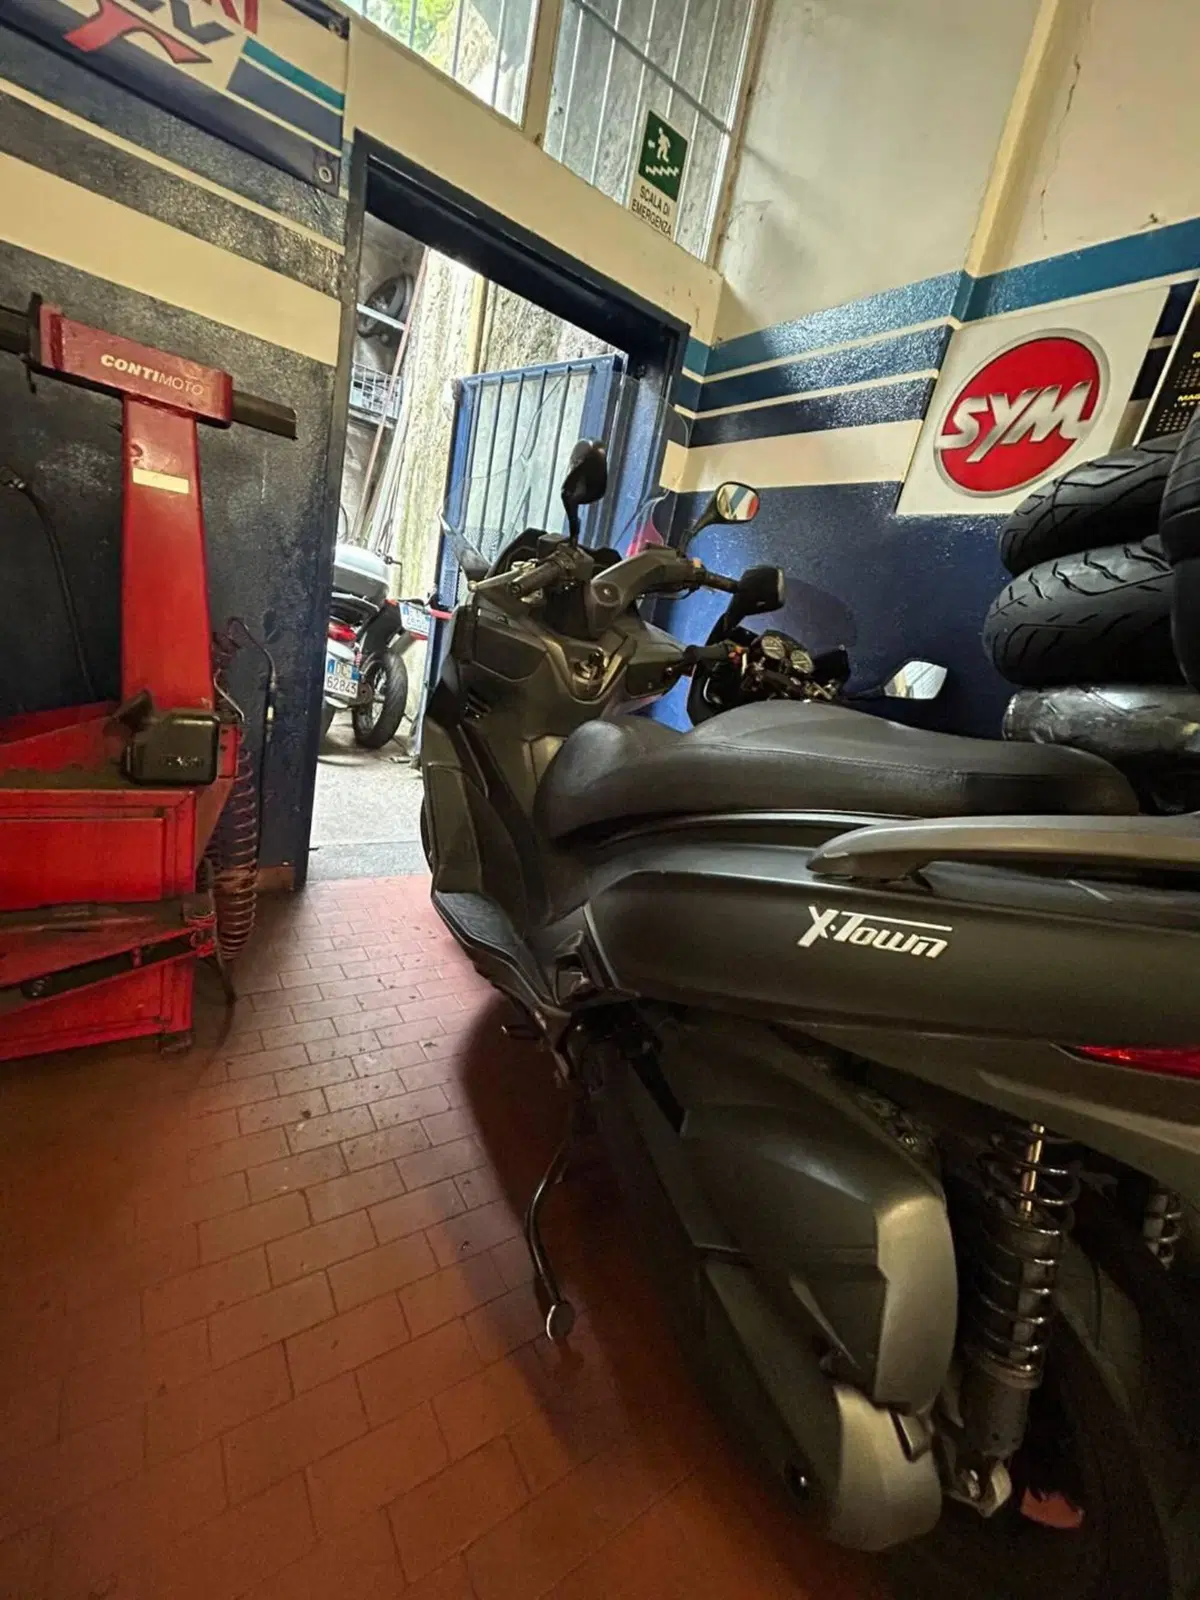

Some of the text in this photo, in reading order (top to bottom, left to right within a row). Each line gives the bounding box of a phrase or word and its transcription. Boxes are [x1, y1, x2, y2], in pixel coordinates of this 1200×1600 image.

[631, 198, 672, 236] EMERGENZA
[640, 185, 670, 216] SCALA DI
[100, 353, 204, 396] CONTIMOTO
[935, 380, 1093, 463] SYM
